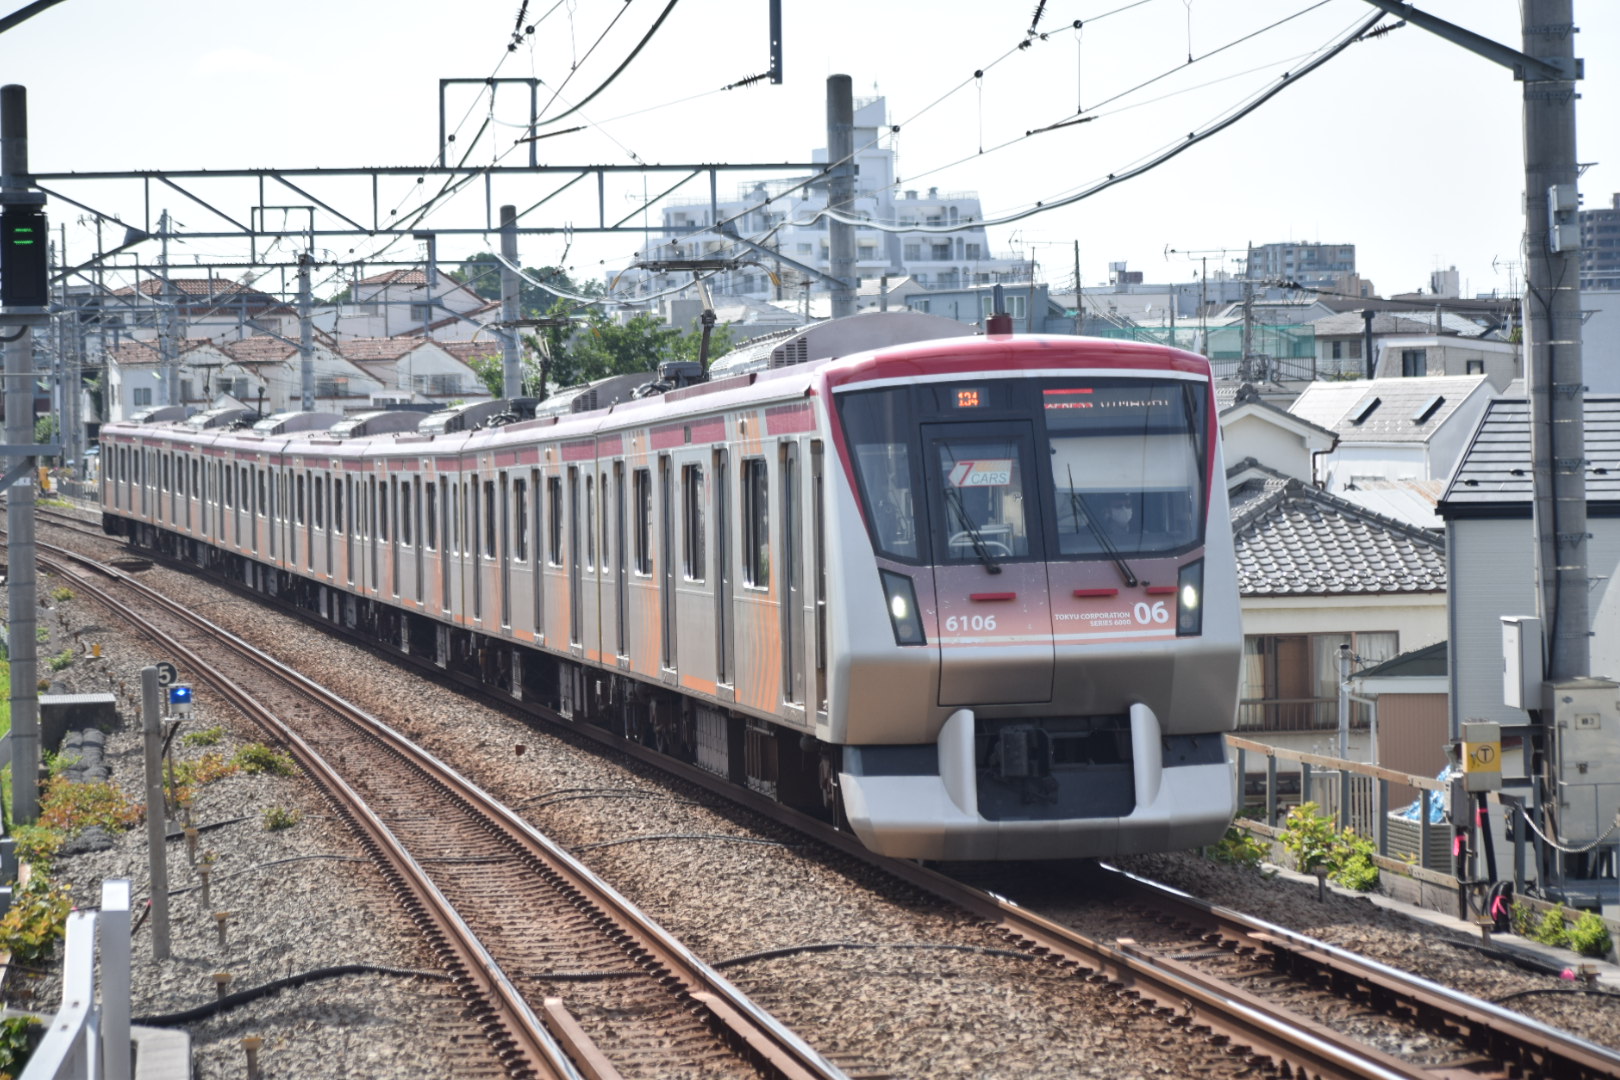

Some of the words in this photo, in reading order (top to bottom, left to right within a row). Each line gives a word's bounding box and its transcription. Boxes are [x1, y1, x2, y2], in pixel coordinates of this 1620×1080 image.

[959, 462, 975, 485] 7
[971, 472, 1008, 485] CARS
[1055, 613, 1079, 621] TOKYU
[1080, 611, 1130, 620] CORPORATION
[1134, 601, 1169, 625] 06
[945, 615, 997, 631] 6106
[159, 665, 171, 684] 5
